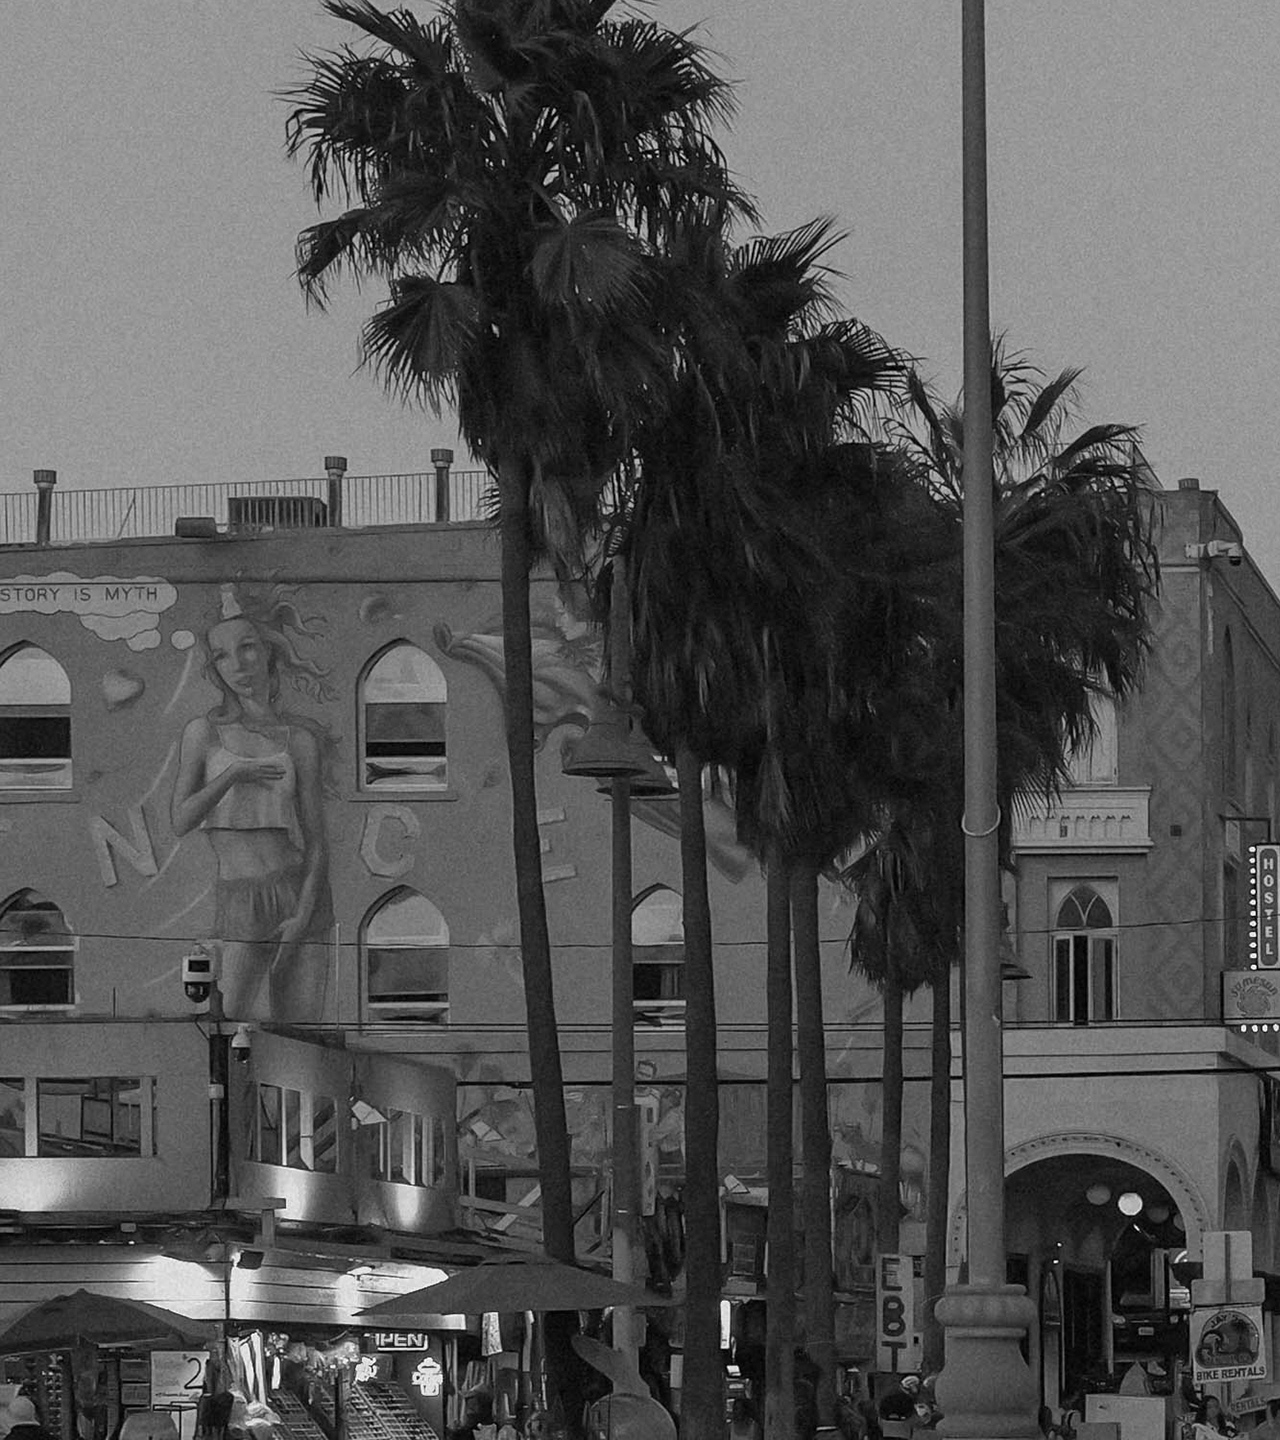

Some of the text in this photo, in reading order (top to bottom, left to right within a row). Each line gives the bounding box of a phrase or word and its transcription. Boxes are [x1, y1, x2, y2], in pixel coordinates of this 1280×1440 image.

[74, 587, 91, 601] IS
[105, 587, 158, 601] MYTH
[1263, 858, 1275, 956] HOSTEL
[881, 1257, 906, 1373] EBT
[1196, 1366, 1265, 1381] BIKE RENTALS
